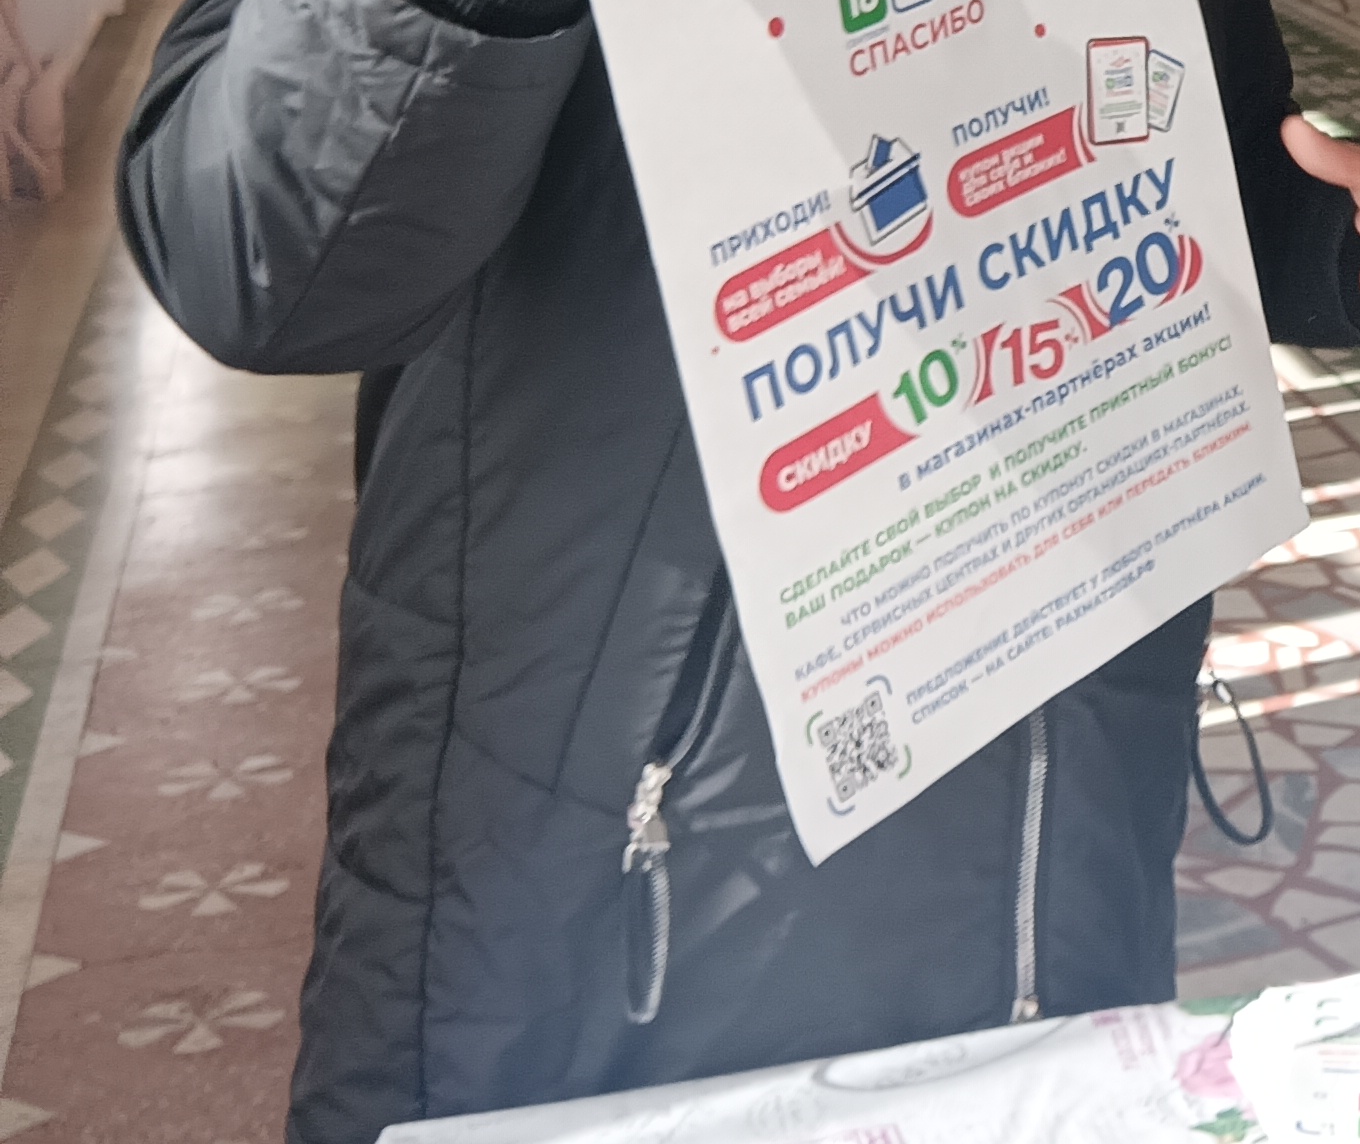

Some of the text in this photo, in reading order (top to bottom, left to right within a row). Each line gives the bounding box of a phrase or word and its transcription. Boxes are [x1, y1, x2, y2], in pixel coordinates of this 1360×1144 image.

[952, 87, 1050, 146] ПОЛУЧИ!
[710, 190, 831, 266] ПРИХОДИ!
[742, 158, 1176, 423] ПОЛУЧИ СКИДКУ
[1142, 304, 1212, 356] акции!
[777, 419, 873, 492] СКИДКУ
[780, 335, 1234, 605] СДЕЛАЙТЕ СВОЙ ВЫБОР И ПОЛУЧИТЕ ПРИЯТНЫЙ БОНУС!
[785, 593, 826, 629] ВАШ
[830, 539, 913, 601] ПОДАРОК
[935, 493, 992, 537] КУПОН
[994, 480, 1018, 503] НА
[1020, 440, 1088, 488] СКИДКУ.
[840, 601, 872, 627] ЧТО
[1011, 508, 1031, 527] ПО
[1096, 436, 1148, 475] СКИДКИ
[1151, 427, 1162, 443] В
[935, 548, 999, 595] ЦЕНТРАХ
[1002, 538, 1012, 554] И
[1015, 509, 1066, 548] ДРУГИХ
[912, 682, 969, 724] СПИСОК
